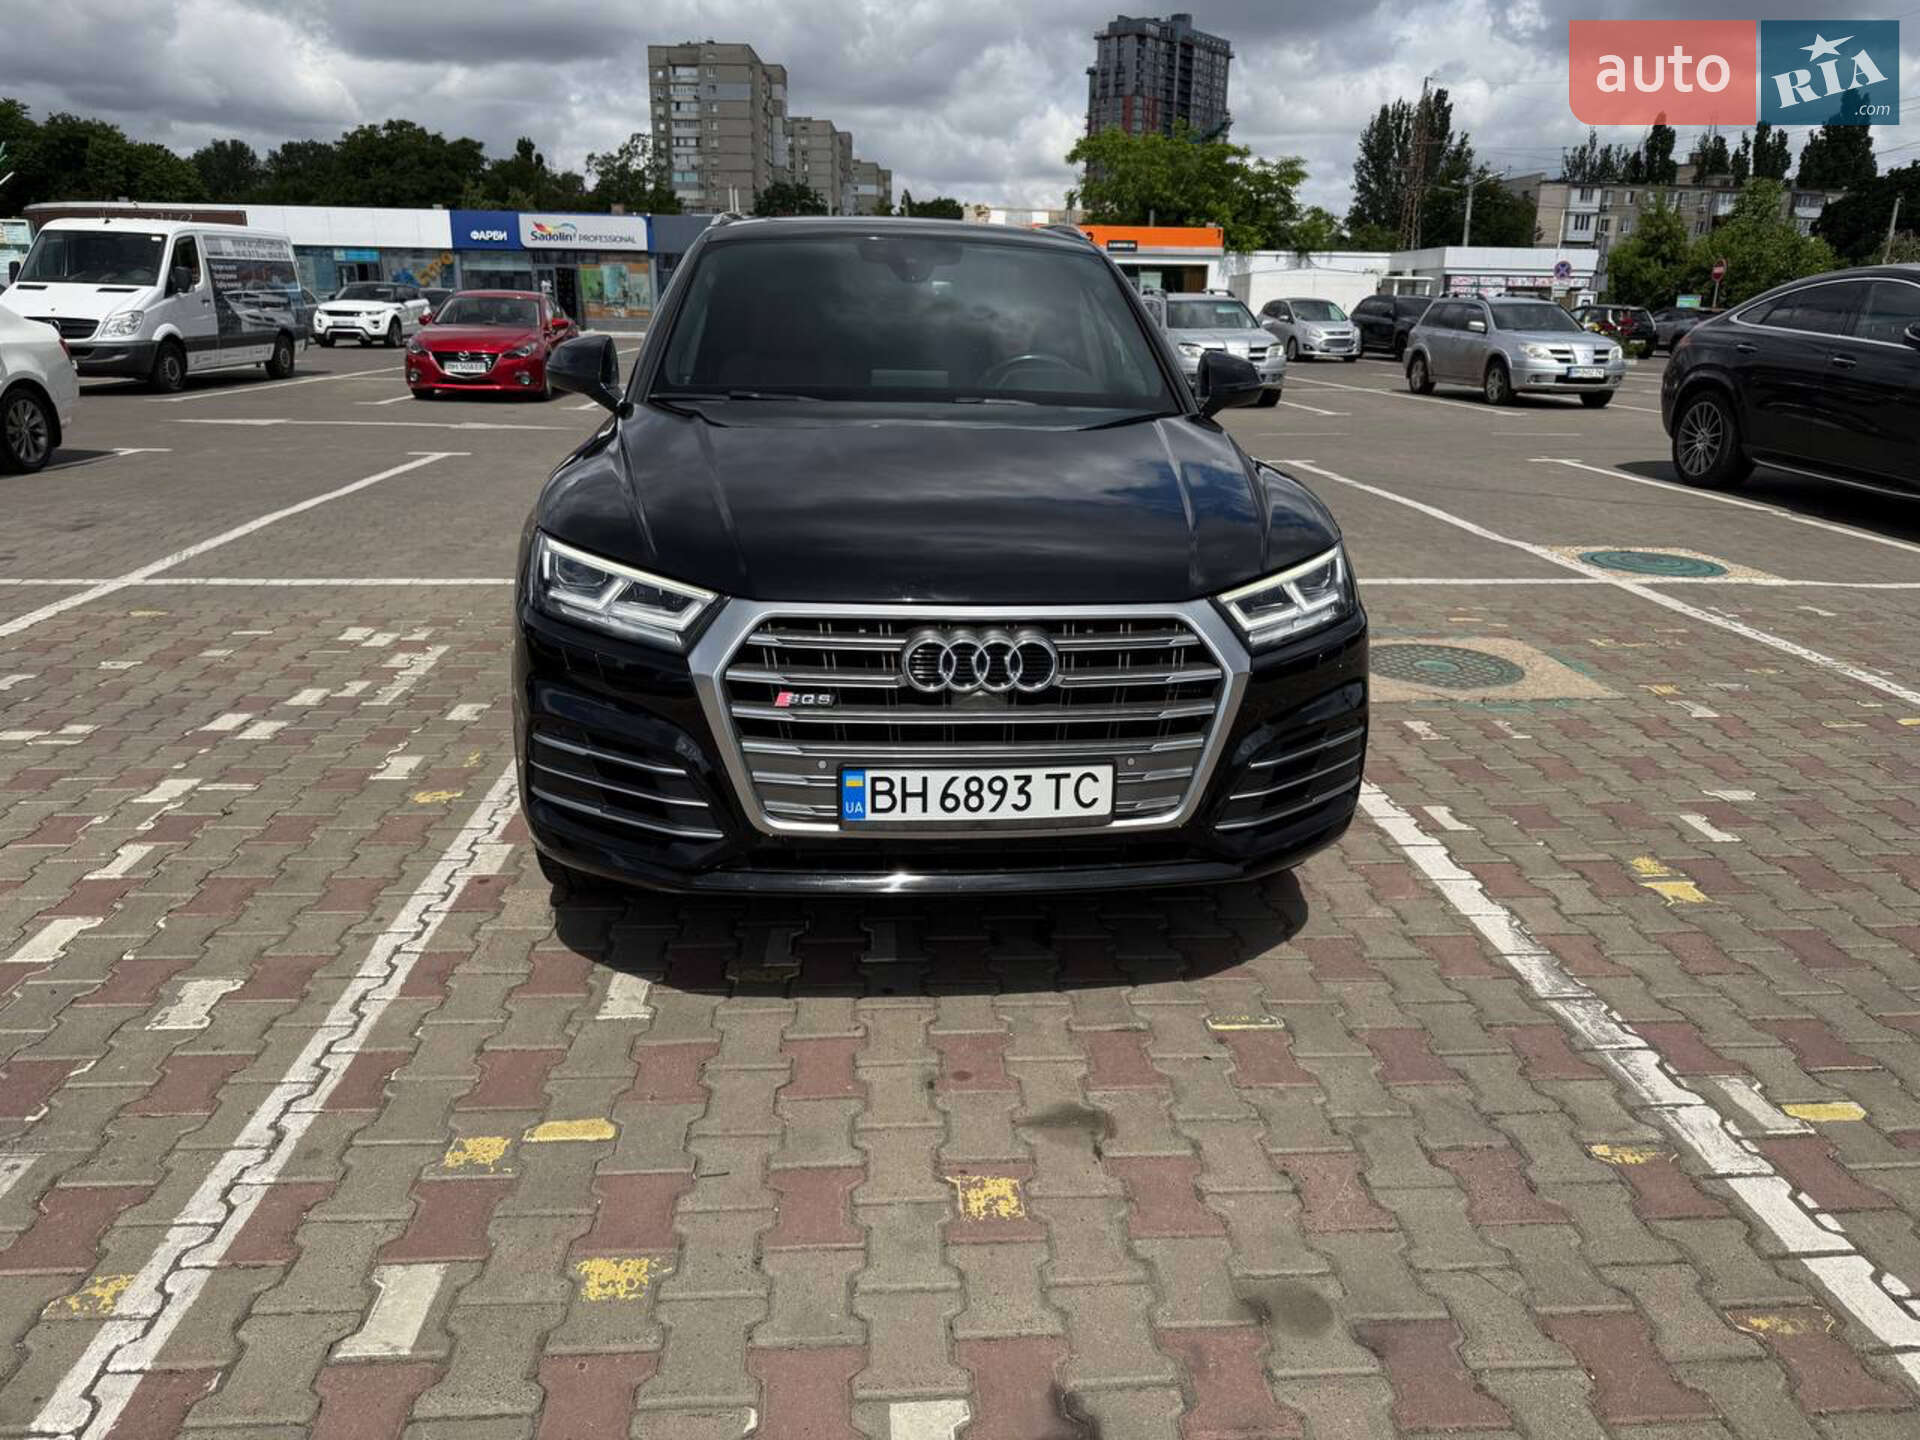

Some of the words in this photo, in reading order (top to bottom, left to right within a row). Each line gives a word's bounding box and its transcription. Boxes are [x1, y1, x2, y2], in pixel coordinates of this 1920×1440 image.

[530, 231, 572, 242] Sadolin
[579, 233, 637, 244] PROFESSIONAL
[870, 776, 928, 815] BH
[939, 775, 1031, 814] 6893
[1045, 772, 1099, 811] TC
[844, 802, 864, 815] UA
